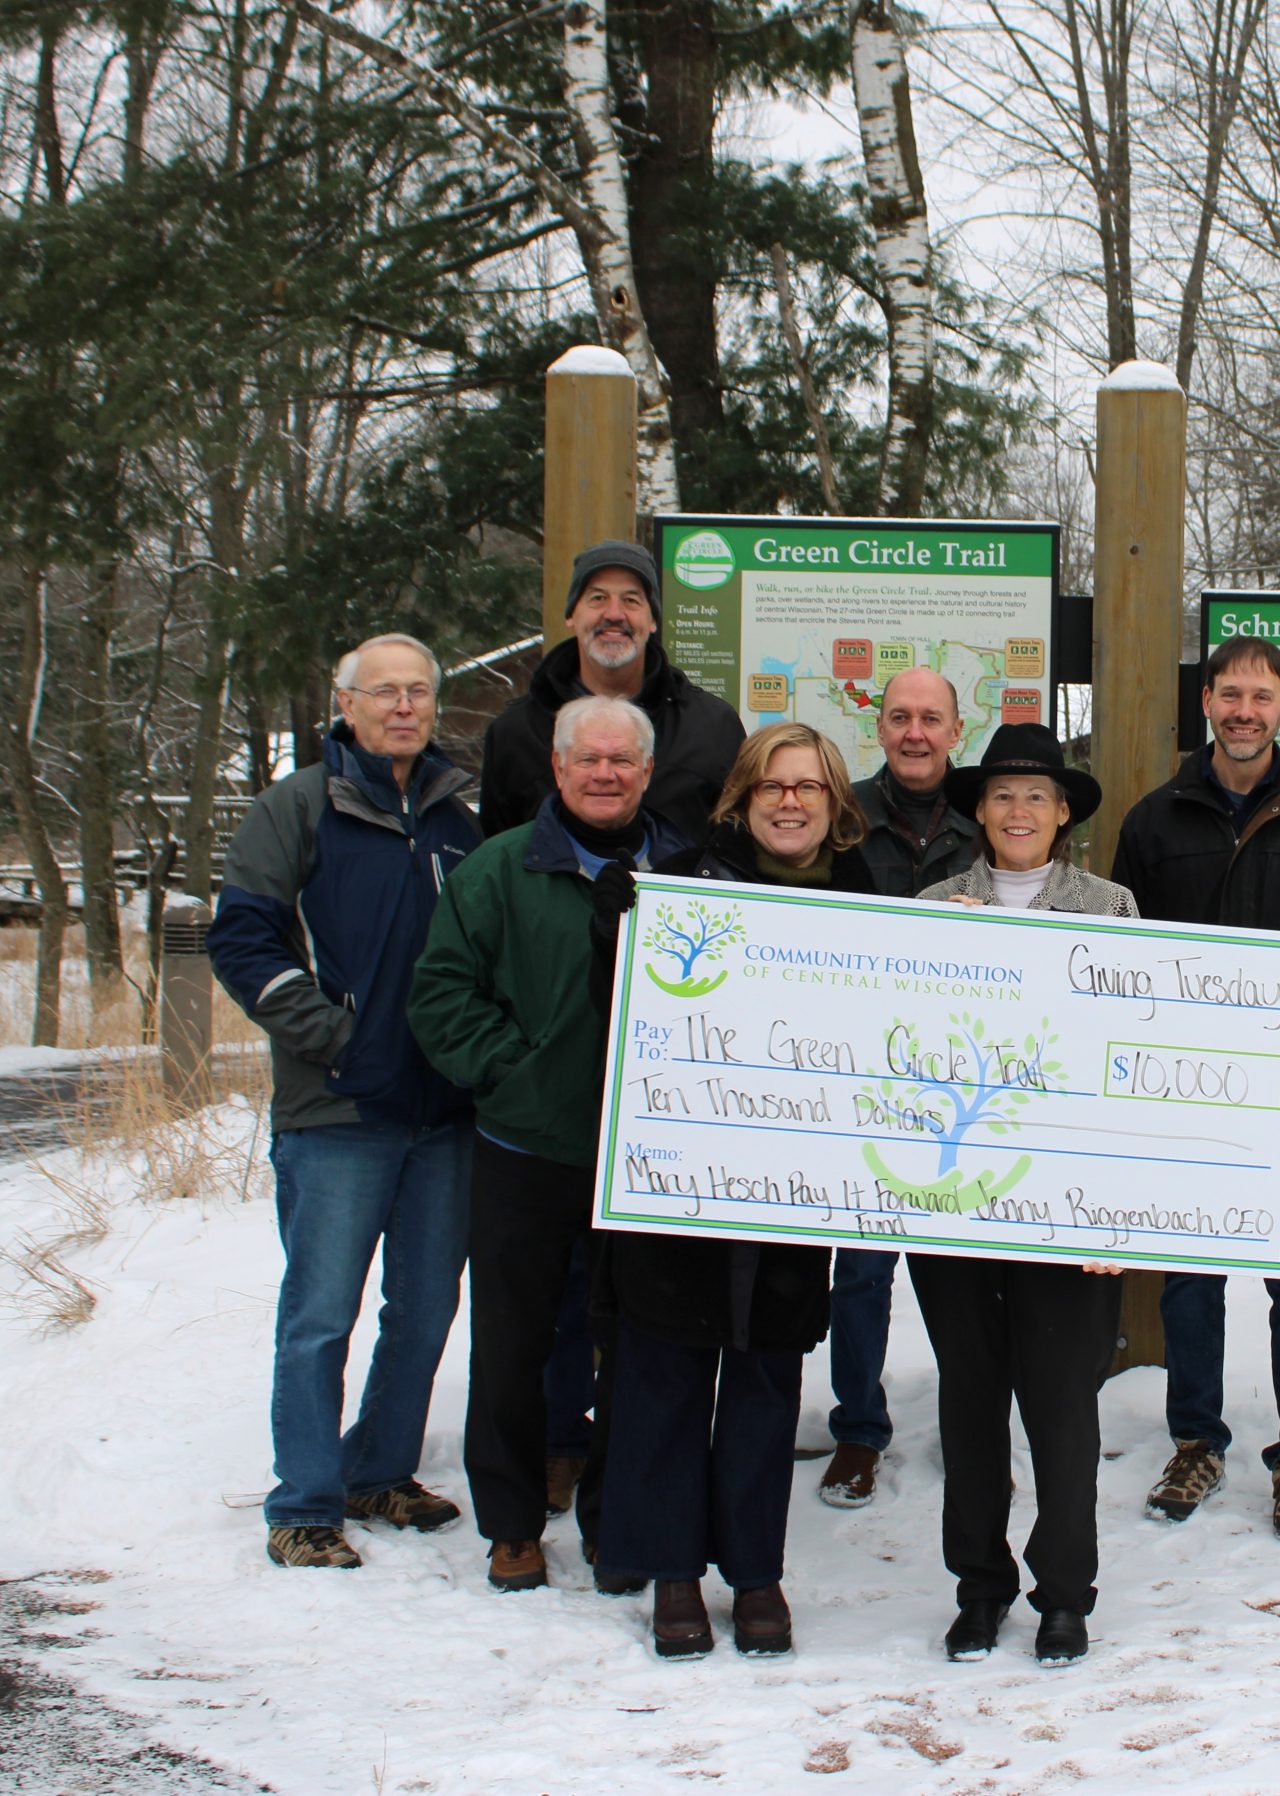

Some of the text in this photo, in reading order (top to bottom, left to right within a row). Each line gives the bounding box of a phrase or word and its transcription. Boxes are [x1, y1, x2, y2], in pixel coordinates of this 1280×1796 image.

[753, 538, 1007, 567] Green Circle Trail
[756, 583, 781, 593] Walk,
[784, 586, 802, 594] run,
[815, 584, 833, 593] bike
[836, 585, 850, 594] the
[852, 585, 878, 595] Green
[880, 585, 905, 595] Circle
[909, 586, 932, 596] Trail.
[934, 589, 961, 598] Journey
[963, 590, 988, 598] through
[890, 598, 926, 606] experience
[1004, 600, 1027, 608] history
[677, 605, 719, 616] Trail Info
[825, 606, 838, 614] The
[965, 610, 1001, 618] connecting
[744, 944, 1024, 984] COMMUNITY FOUNDATION
[743, 964, 1022, 1001] OF CENTRAL WISCONSIN
[1068, 943, 1156, 1021] Giving
[634, 1019, 673, 1045] Pay
[636, 1040, 669, 1061] To:
[672, 1010, 1047, 1091] The Green Circle Trail
[627, 1072, 692, 1114] Ten
[853, 1093, 946, 1134] Dollars
[625, 1142, 683, 1162] Memo:
[625, 1155, 1274, 1248] Mary Hesch Pay It Forward Jenny Riggenbach, CEO
[855, 1212, 908, 1238] Fund
